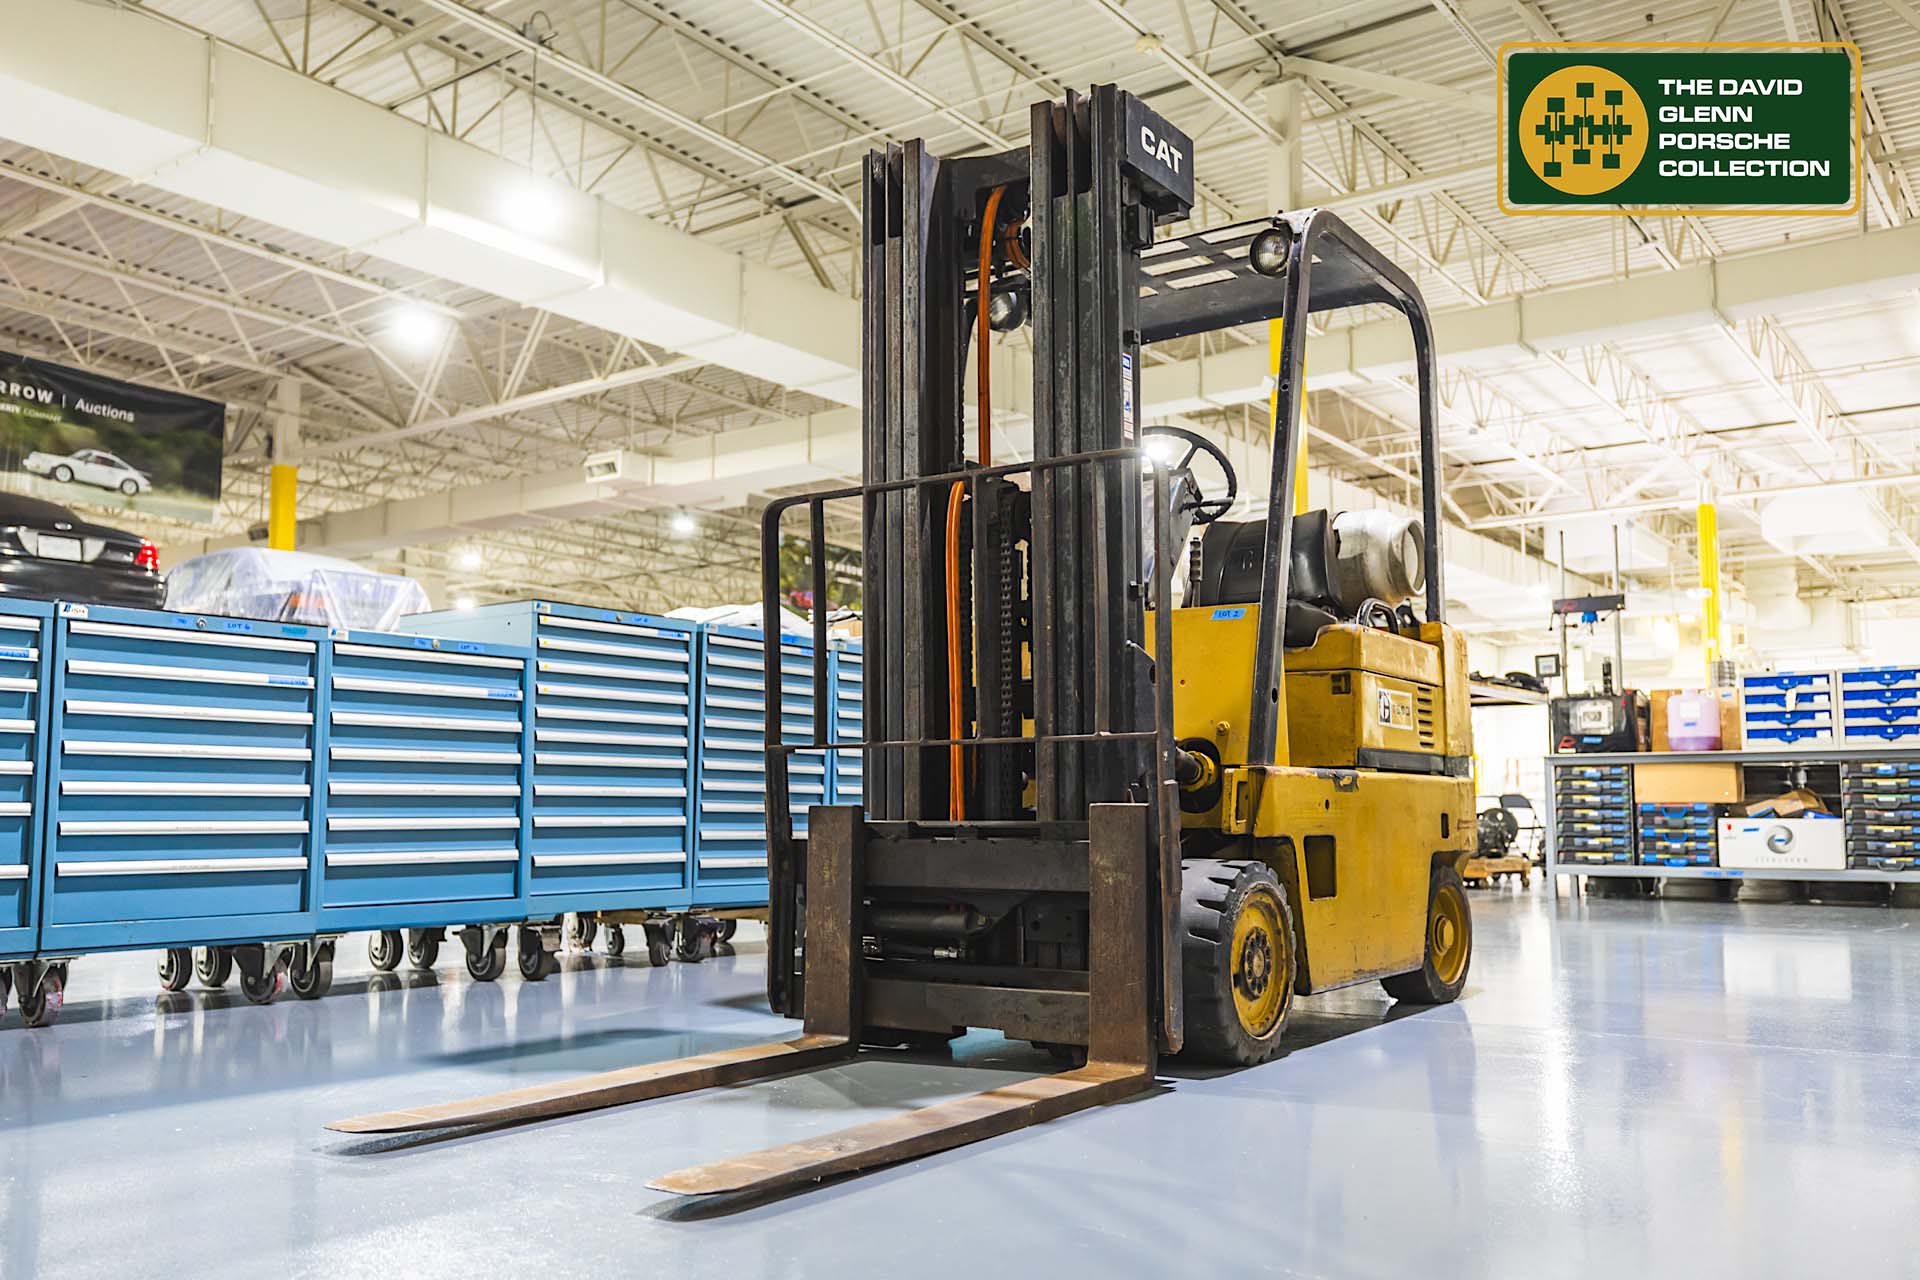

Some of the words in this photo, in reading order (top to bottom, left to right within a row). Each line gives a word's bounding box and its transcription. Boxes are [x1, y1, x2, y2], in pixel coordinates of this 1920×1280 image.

[1141, 125, 1183, 174] CAT
[75, 398, 135, 422] Auctions
[227, 622, 242, 630] LOT
